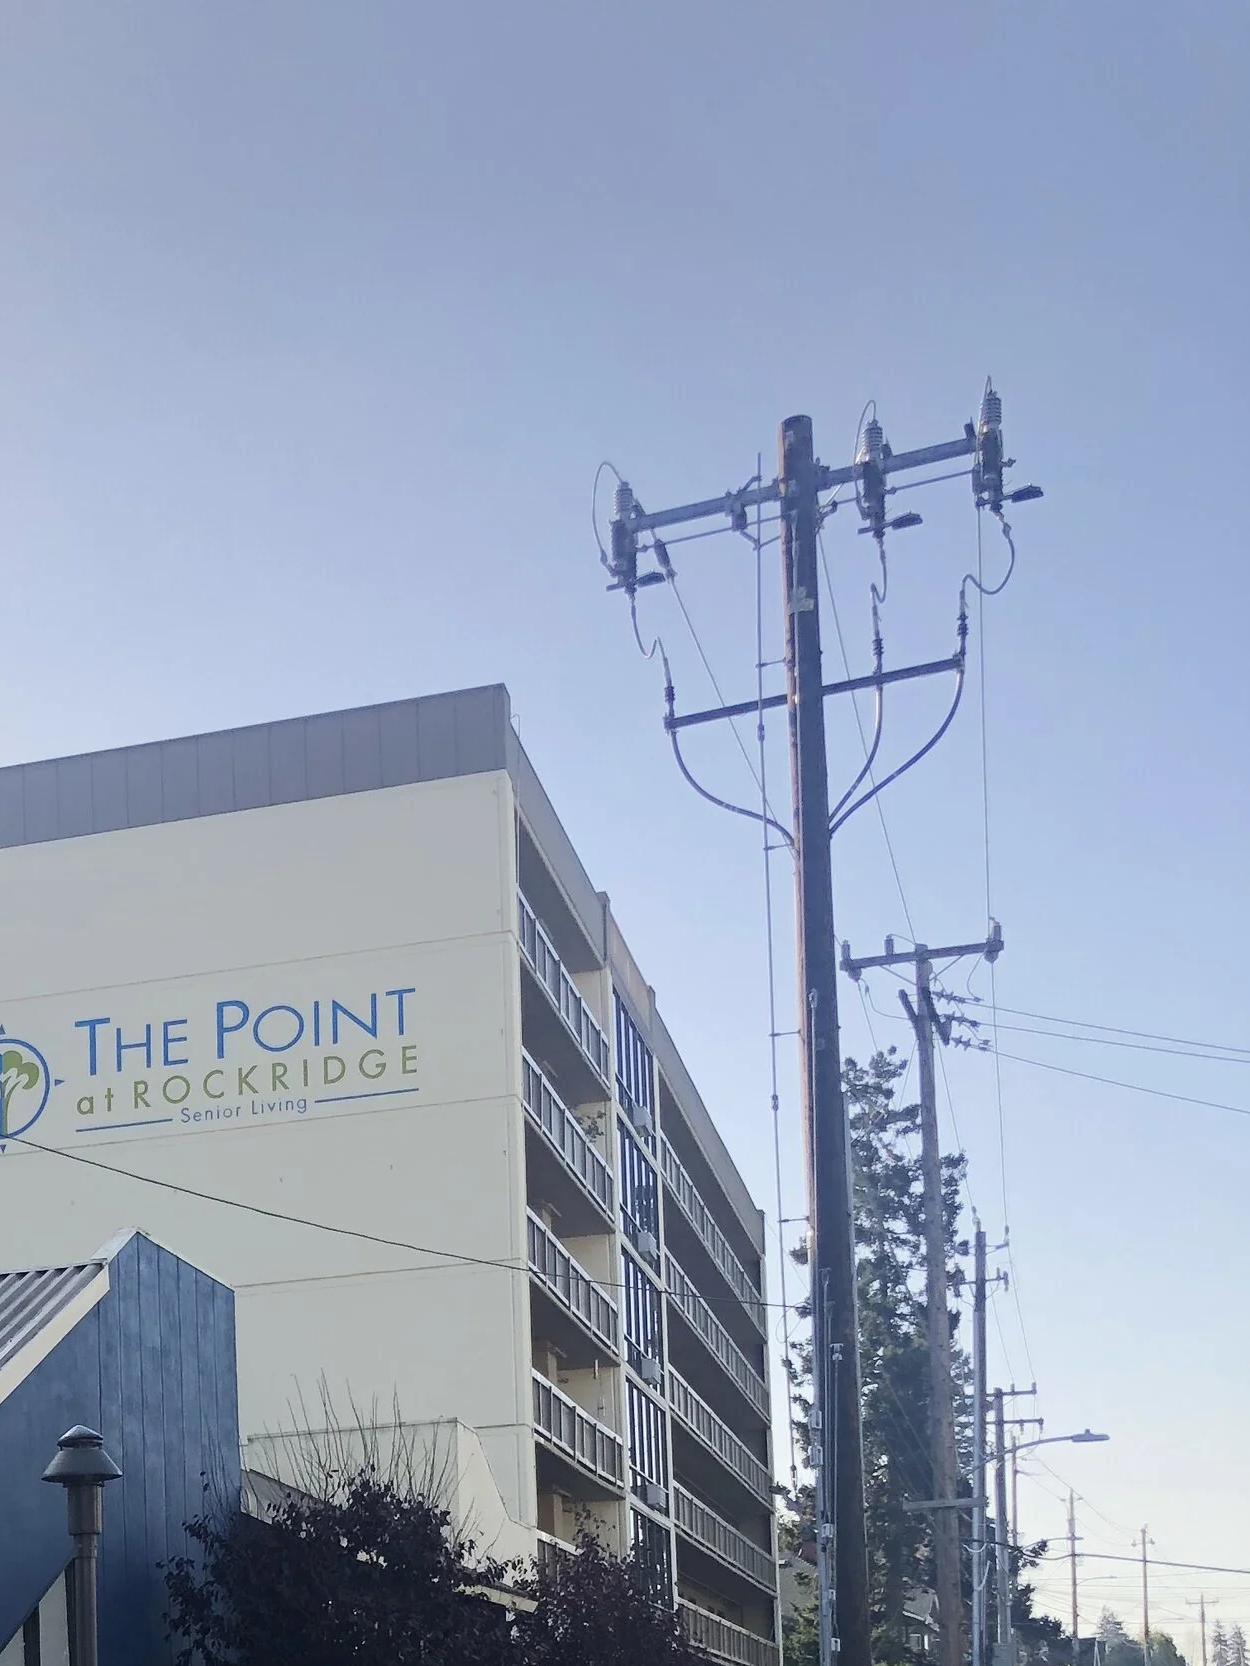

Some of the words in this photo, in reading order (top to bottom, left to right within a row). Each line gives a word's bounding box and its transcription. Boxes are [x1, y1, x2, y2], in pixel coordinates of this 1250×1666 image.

[75, 1017, 188, 1076] THE
[216, 988, 416, 1060] POINT
[76, 1087, 114, 1116] at
[133, 1044, 418, 1110] ROCKRIDGE
[180, 1105, 242, 1124] Senior
[251, 1097, 307, 1115] Living
